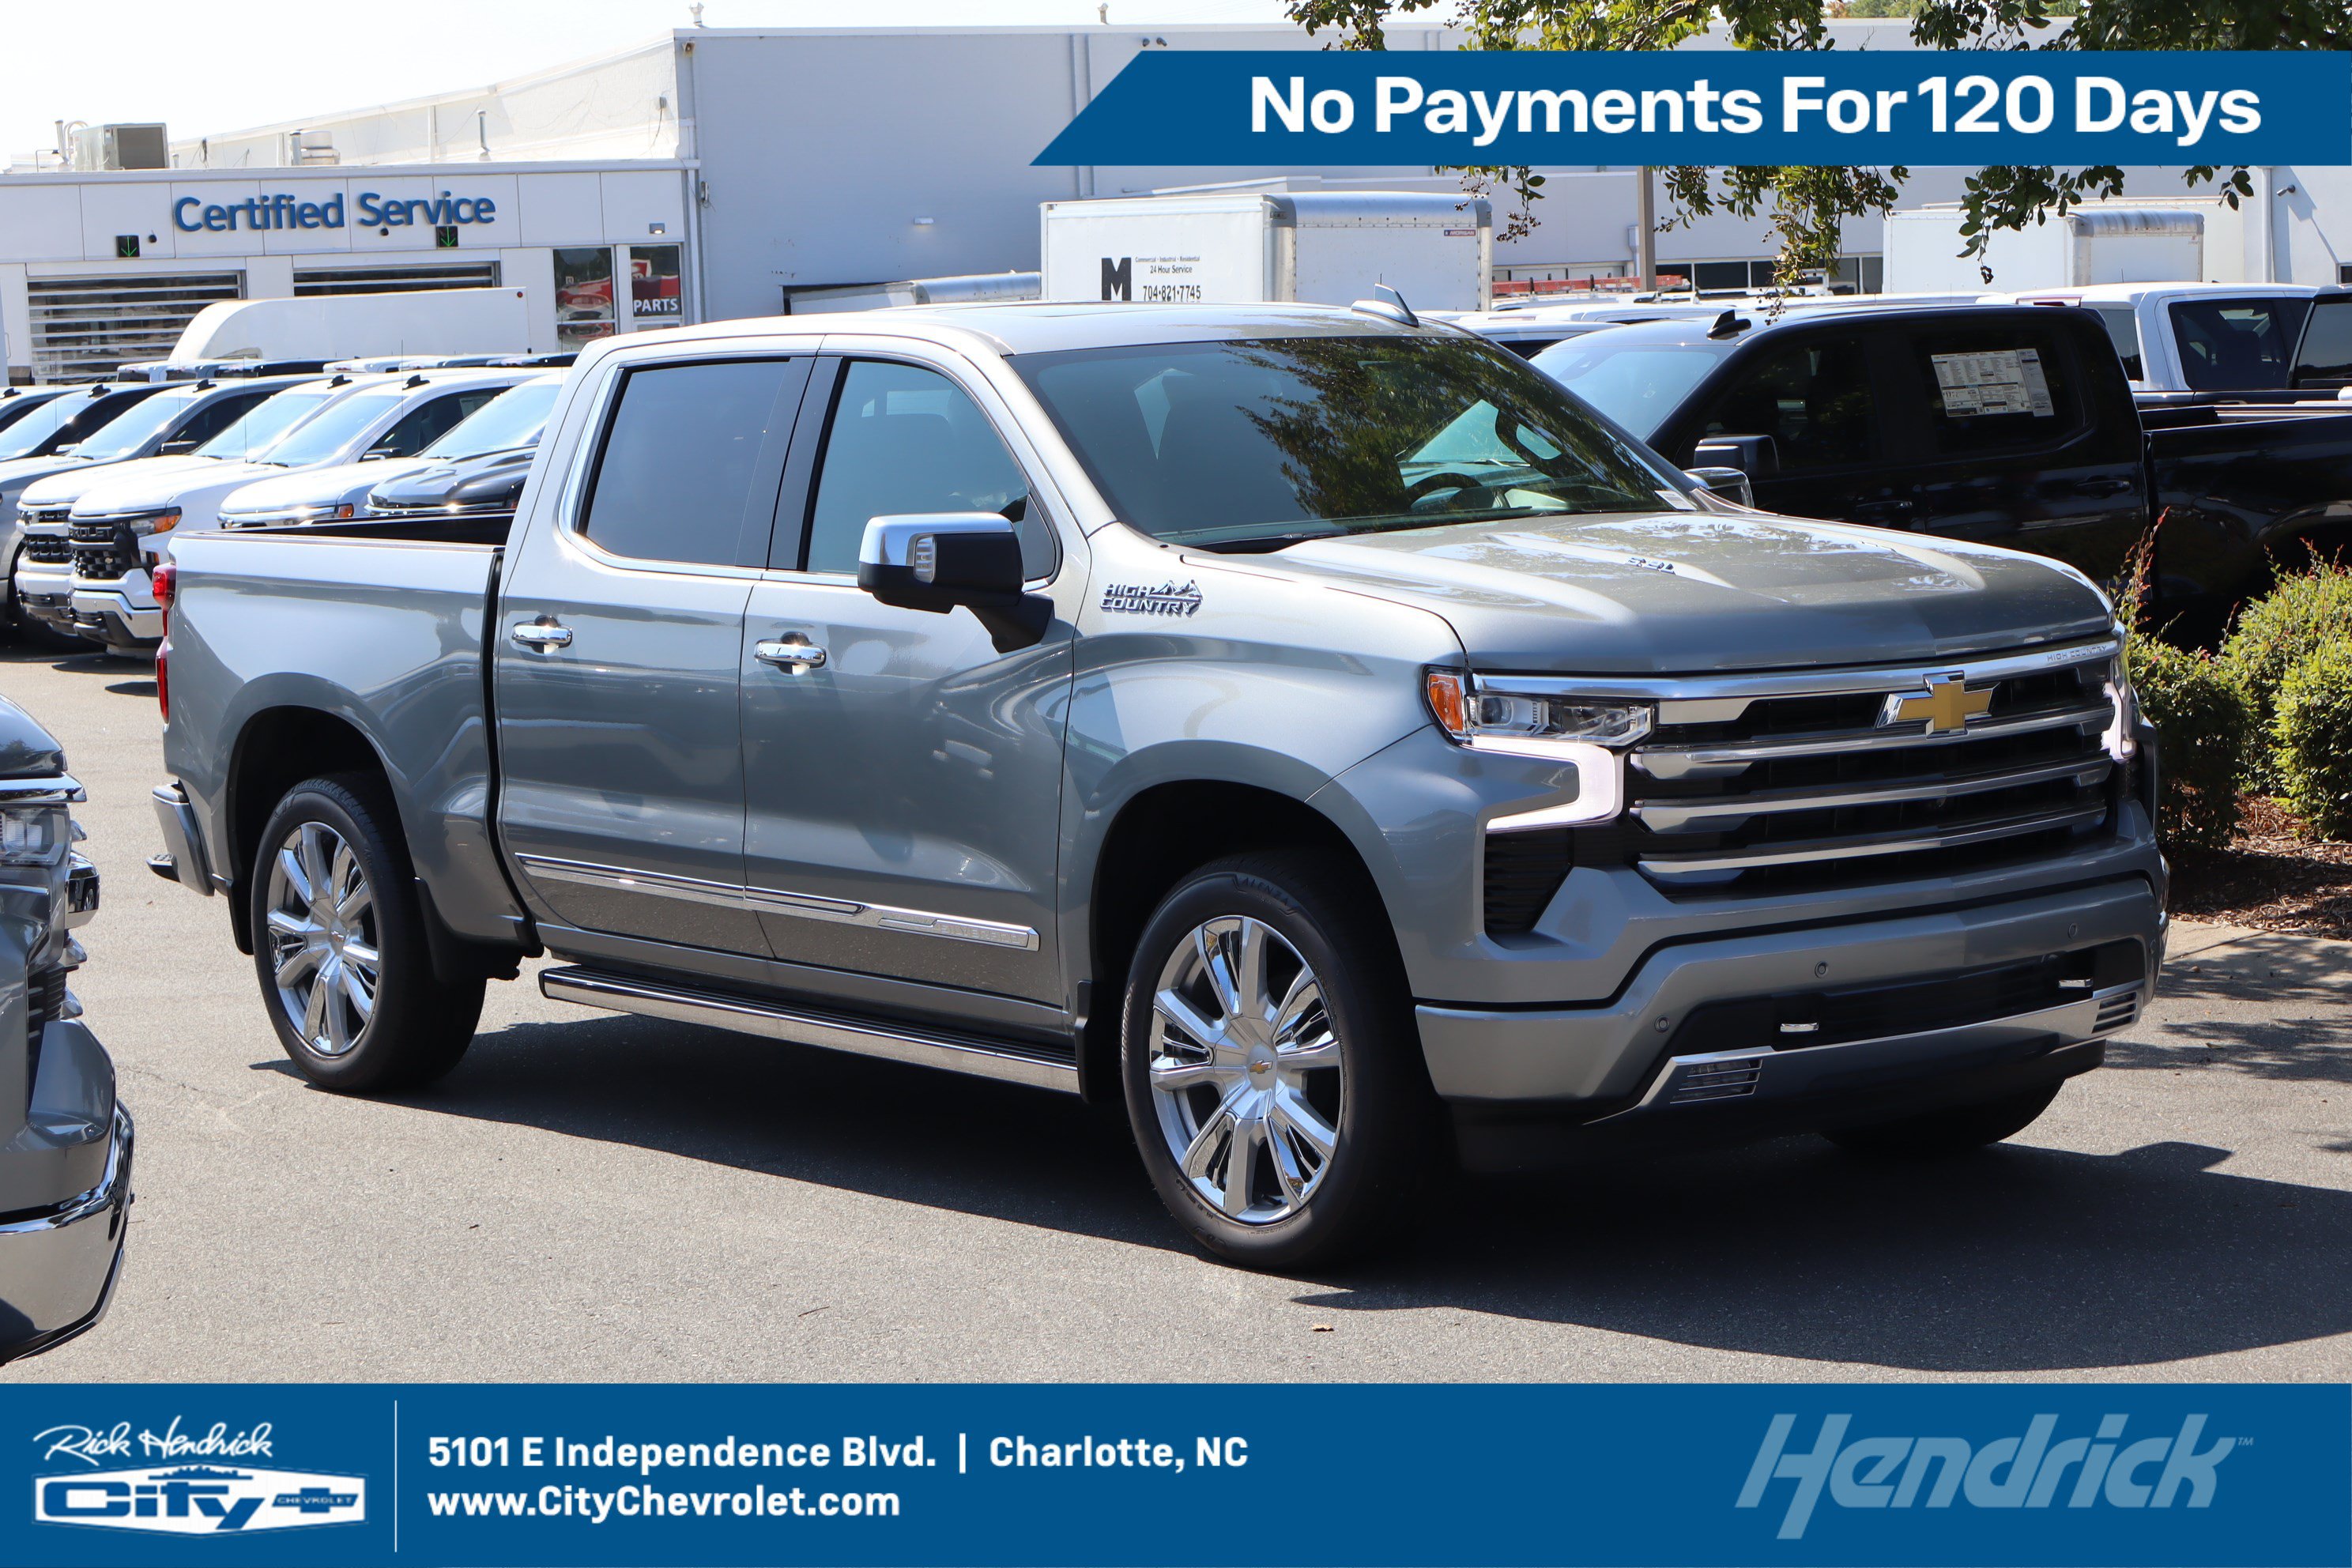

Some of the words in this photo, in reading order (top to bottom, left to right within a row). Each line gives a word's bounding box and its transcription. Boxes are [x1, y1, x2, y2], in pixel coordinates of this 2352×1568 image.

[174, 193, 345, 232] Certified
[357, 190, 496, 228] Service
[1171, 264, 1193, 273] Service
[633, 298, 679, 313] PARTS
[1099, 597, 1200, 616] COUNTRY
[2047, 654, 2068, 662] HIGH
[2071, 645, 2107, 658] COUNTRY
